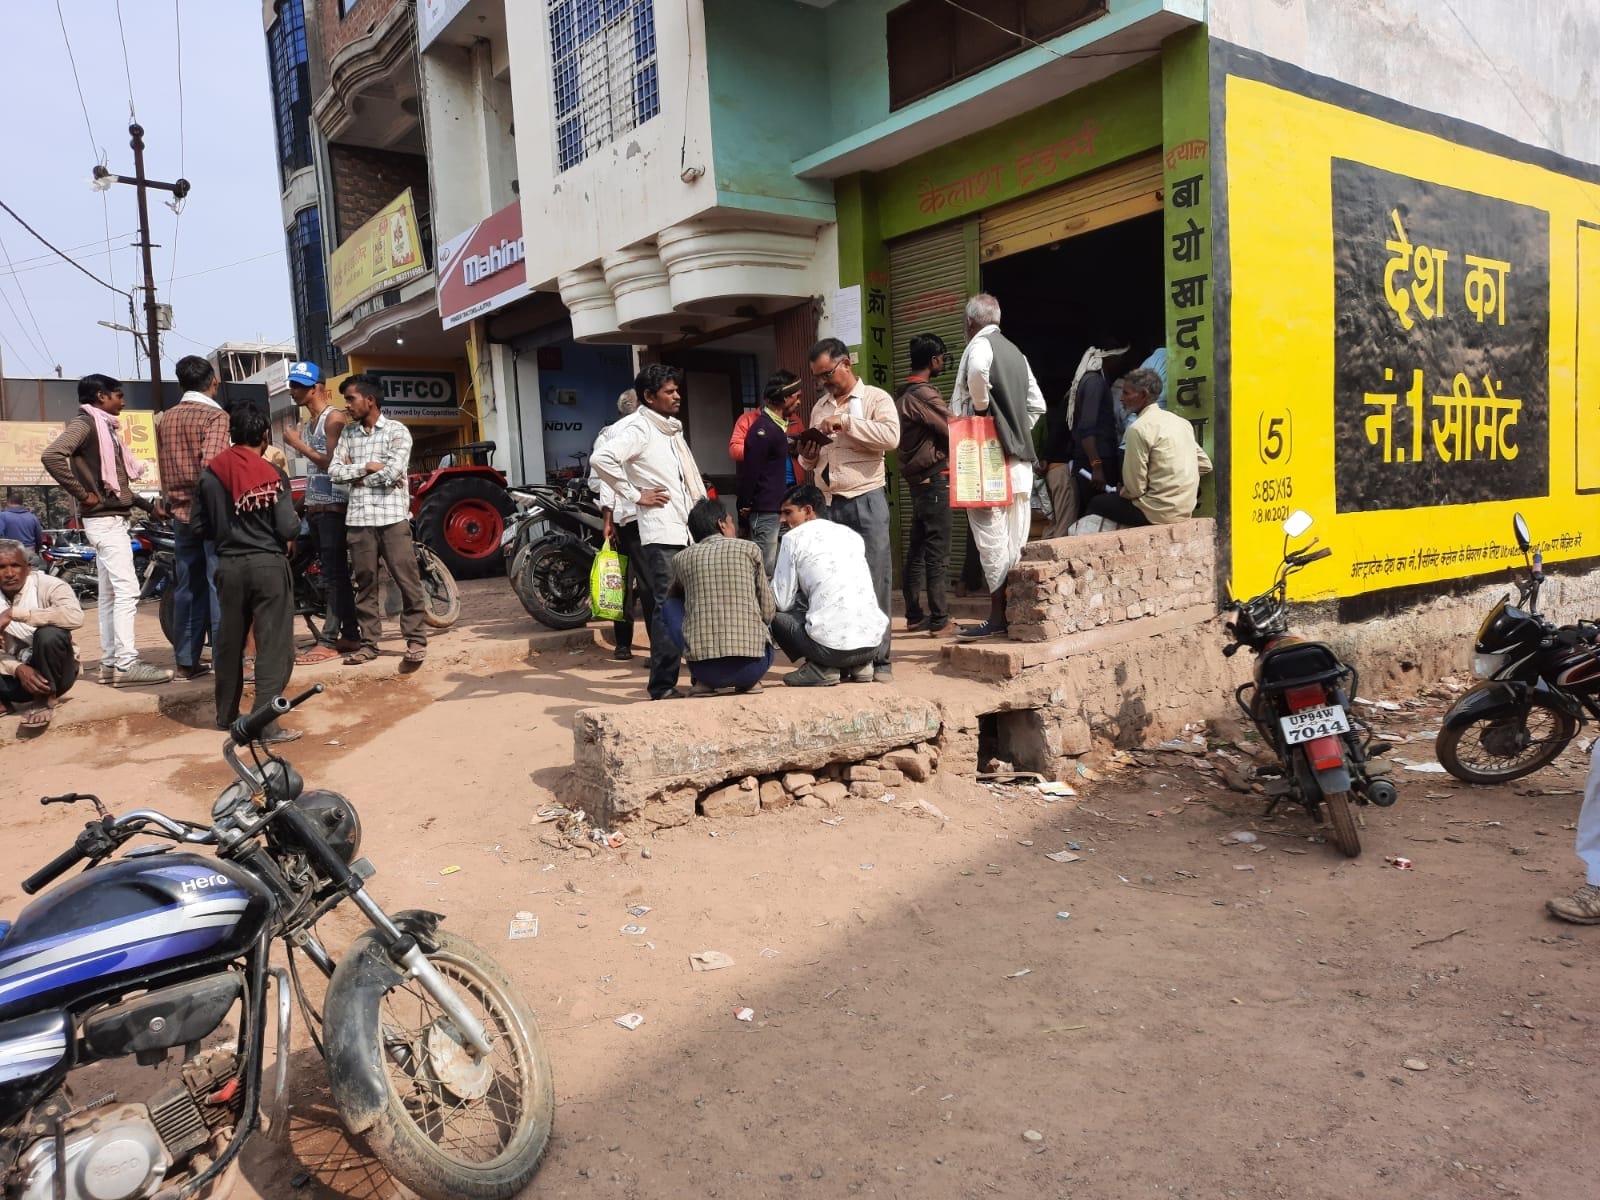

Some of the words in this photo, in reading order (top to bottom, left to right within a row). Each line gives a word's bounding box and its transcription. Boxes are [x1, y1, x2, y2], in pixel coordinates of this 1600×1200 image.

[1384, 208, 1448, 330] देश
[1464, 254, 1511, 326] का
[383, 380, 444, 399] IFFCO
[544, 422, 582, 432] NOVO
[1431, 372, 1522, 463] सीमेंट
[1396, 556, 1408, 572] का
[1289, 708, 1334, 725] UP94W
[1289, 720, 1345, 741] 7044
[181, 874, 228, 893] Hero
